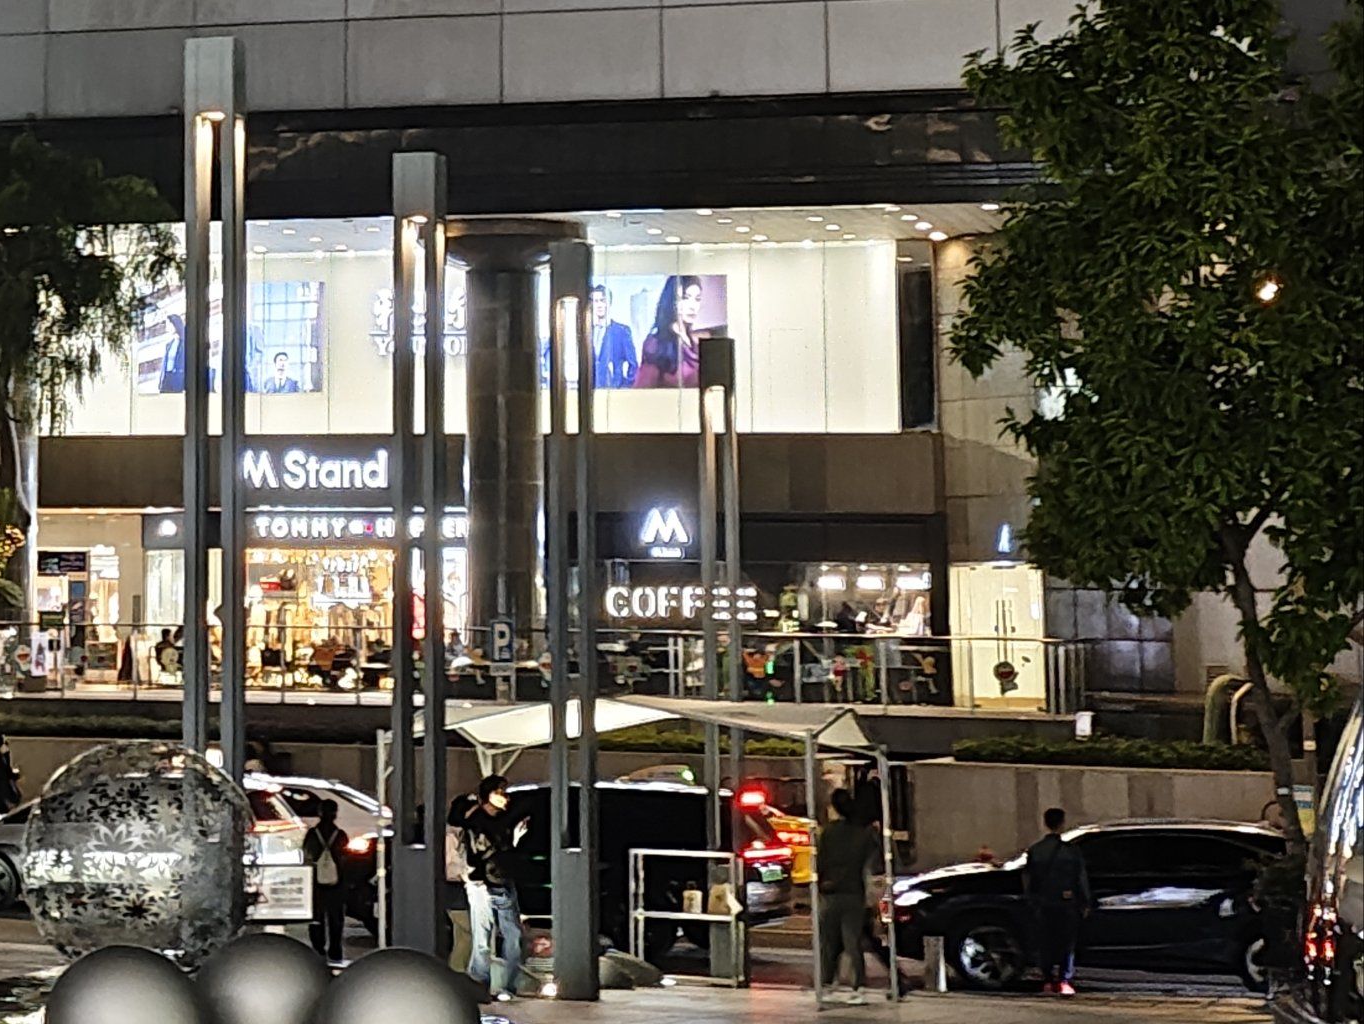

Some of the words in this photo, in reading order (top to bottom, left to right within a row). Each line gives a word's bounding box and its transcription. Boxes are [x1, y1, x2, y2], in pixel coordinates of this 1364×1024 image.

[242, 450, 280, 489] M
[283, 448, 389, 490] Stand
[253, 516, 347, 540] TOMMY
[605, 585, 758, 622] COFFEE
[493, 622, 511, 661] P
